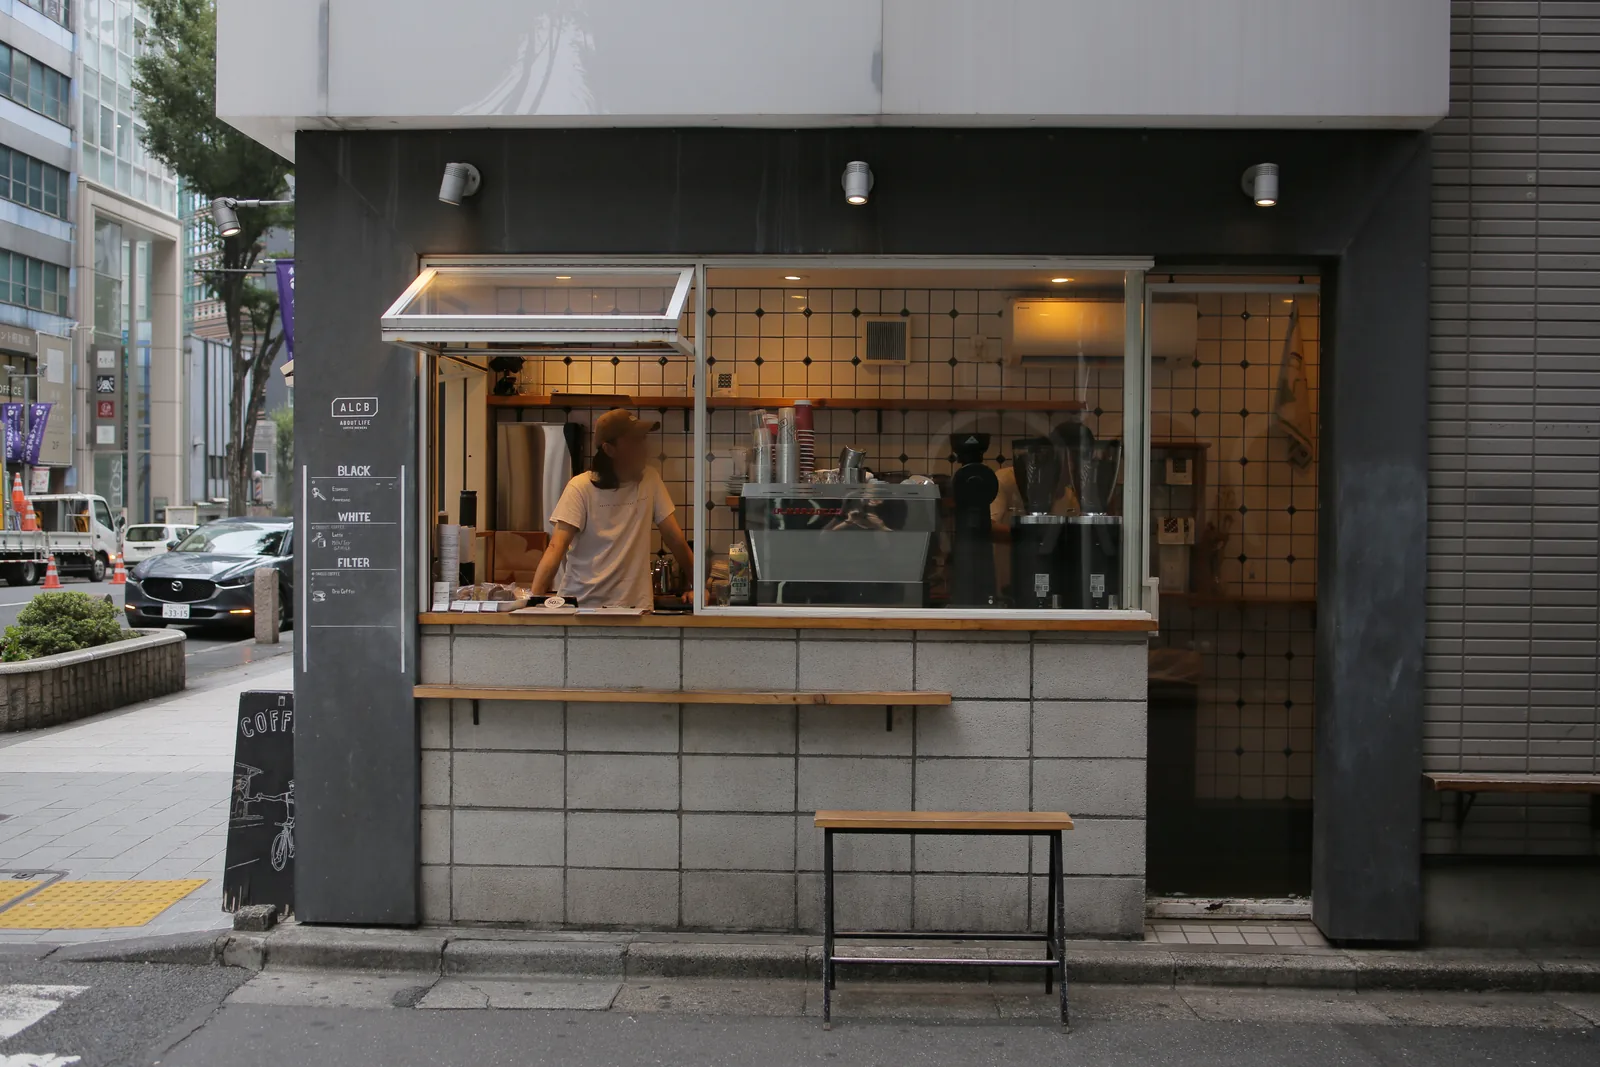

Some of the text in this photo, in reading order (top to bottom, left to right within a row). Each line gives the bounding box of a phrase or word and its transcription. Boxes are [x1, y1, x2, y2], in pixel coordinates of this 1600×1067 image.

[0, 384, 22, 396] OFFCE
[340, 402, 370, 412] ALCB
[337, 465, 371, 476] BLACK
[337, 512, 371, 522] WHITE
[337, 557, 370, 568] FILTER
[240, 709, 294, 738] COFF
